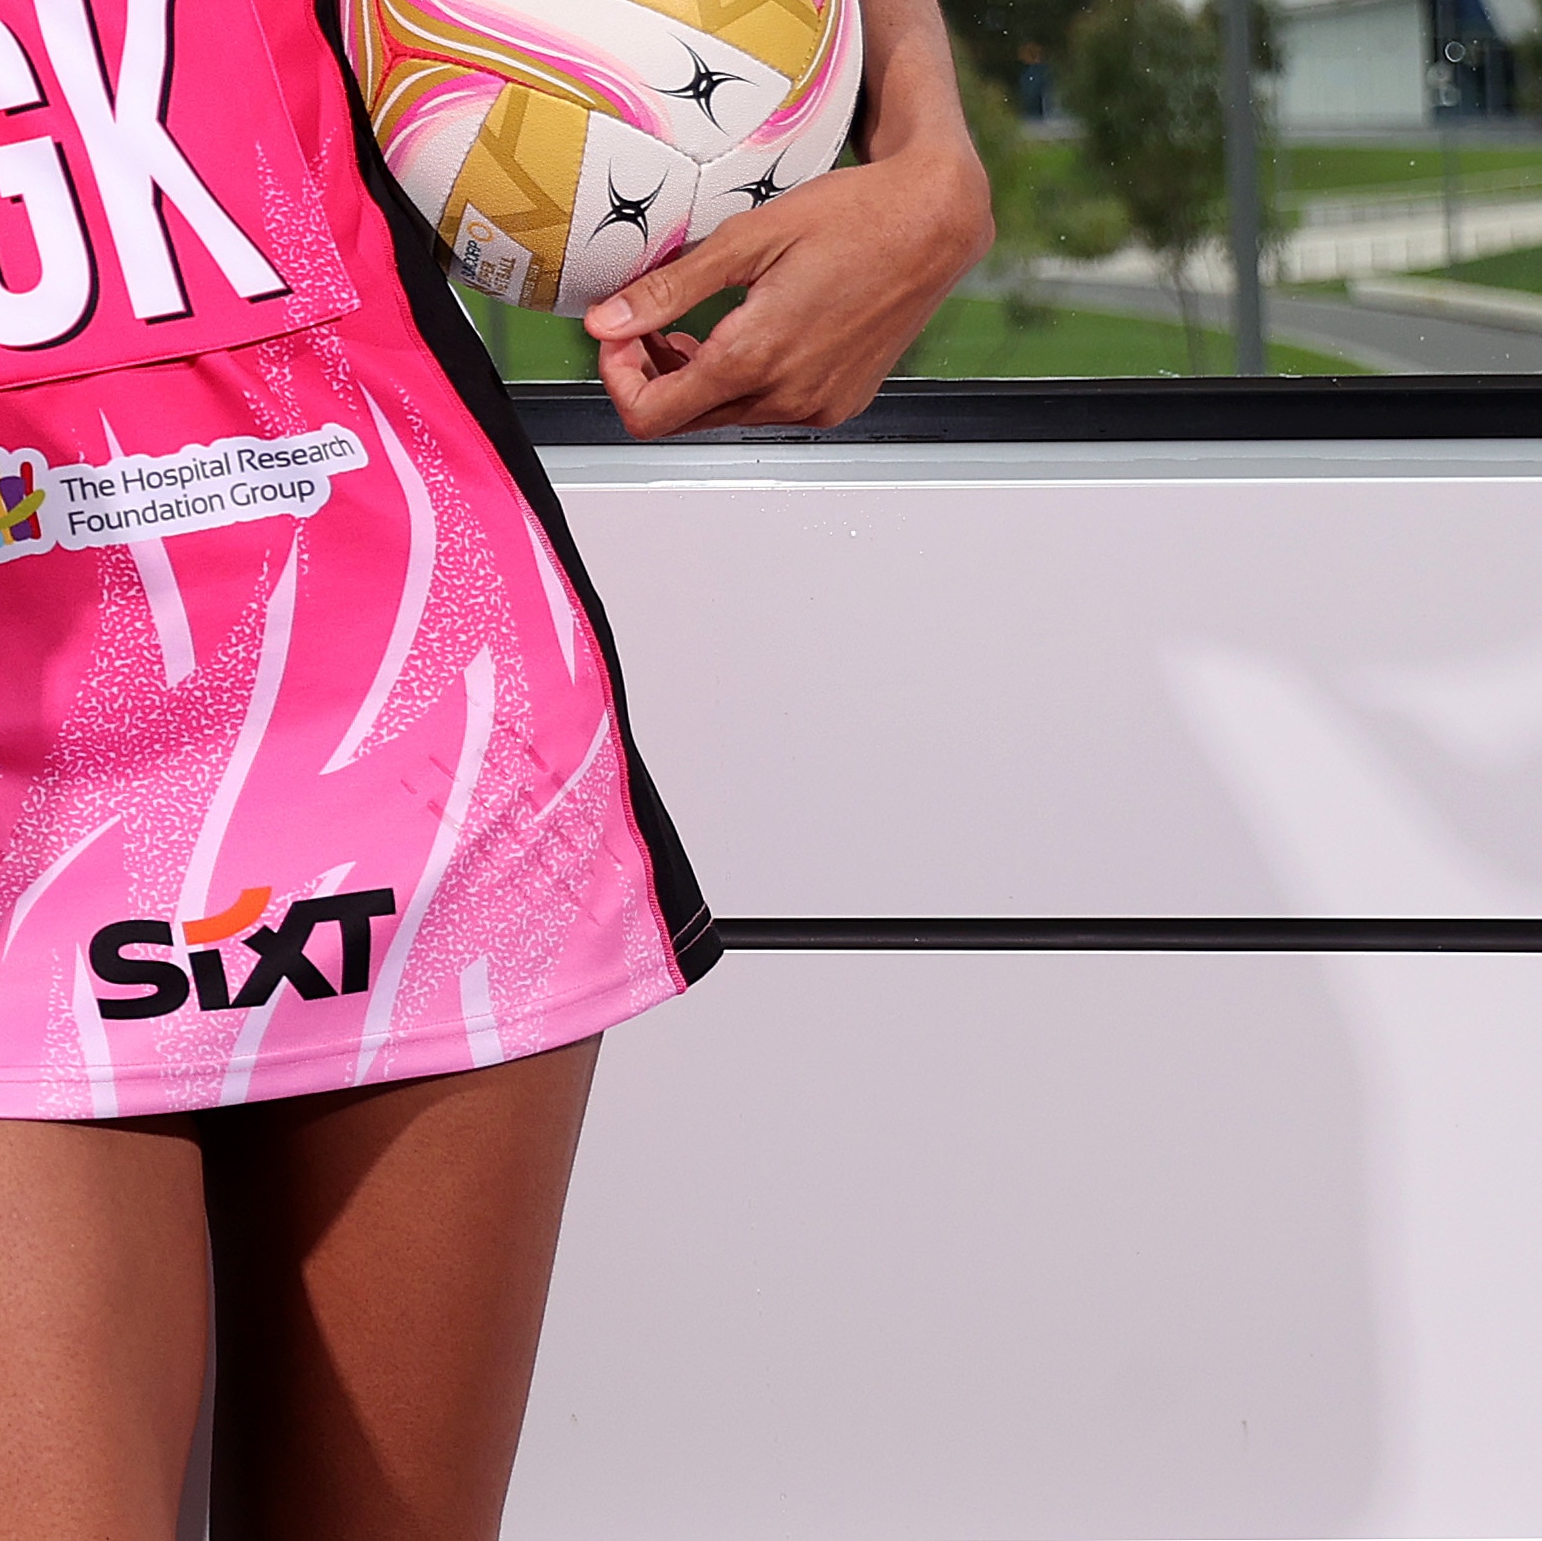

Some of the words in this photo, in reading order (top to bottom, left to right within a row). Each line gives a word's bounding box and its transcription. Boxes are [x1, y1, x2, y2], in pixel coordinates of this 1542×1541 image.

[60, 477, 116, 503] The
[121, 453, 232, 493] Hospital
[237, 435, 355, 473] Research
[67, 493, 226, 535] Foundation
[230, 478, 315, 503] Group
